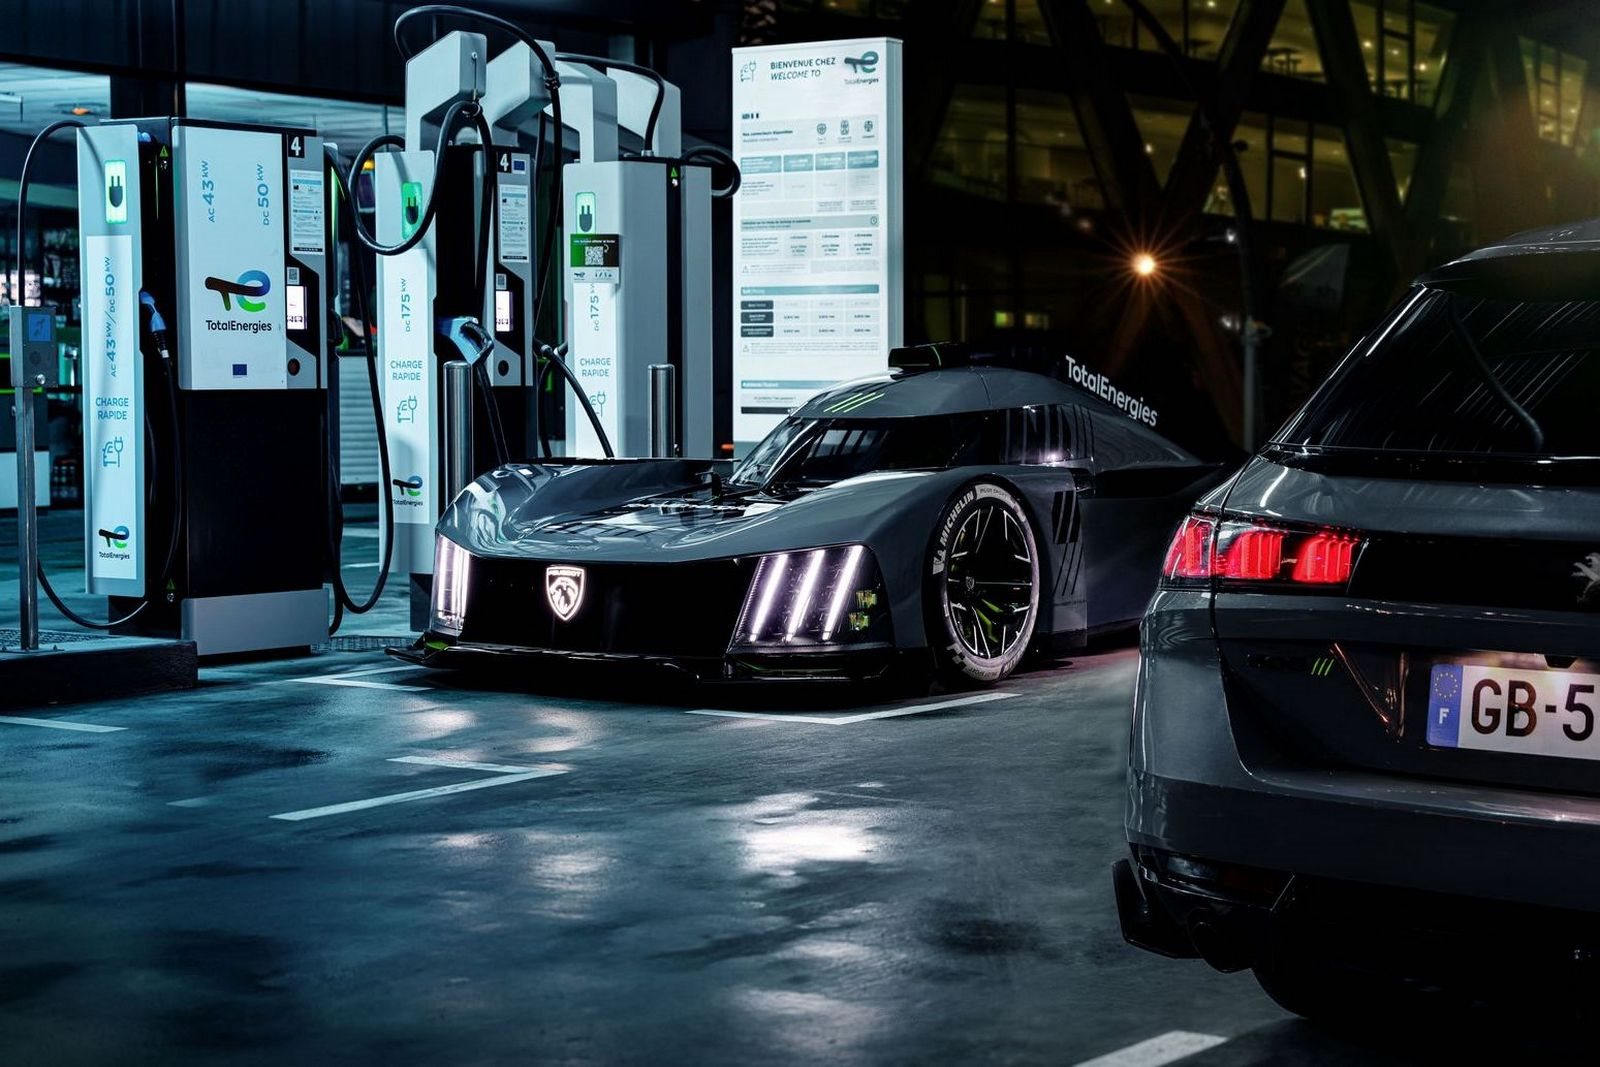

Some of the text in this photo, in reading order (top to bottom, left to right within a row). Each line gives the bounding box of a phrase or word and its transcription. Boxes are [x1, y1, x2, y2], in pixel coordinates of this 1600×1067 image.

[770, 57, 837, 70] BIENVENUE CHEZ
[770, 69, 821, 81] WELCOME TO
[290, 136, 301, 156] 4
[500, 153, 509, 172] 4
[201, 160, 215, 223] AC 43 kW
[257, 164, 269, 226] DC 50 kW
[105, 273, 115, 297] 50
[401, 293, 410, 319] 175
[590, 296, 599, 319] 175
[205, 320, 272, 334] TotalEnergies
[405, 320, 411, 332] DC
[106, 339, 116, 363] 43
[390, 360, 423, 369] CHARGE
[580, 357, 612, 366] CHARGE
[111, 365, 117, 378] AC
[392, 372, 421, 381] RAPIDE
[581, 369, 609, 377] RAPIDE
[1065, 354, 1158, 427] TotalEnergies
[96, 397, 129, 407] CHARGE
[98, 410, 128, 420] RAPIDE
[940, 490, 974, 547] MICHELIN
[99, 551, 130, 561] TotalEnergies
[1438, 707, 1450, 724] F
[1471, 678, 1595, 742] GB-5
